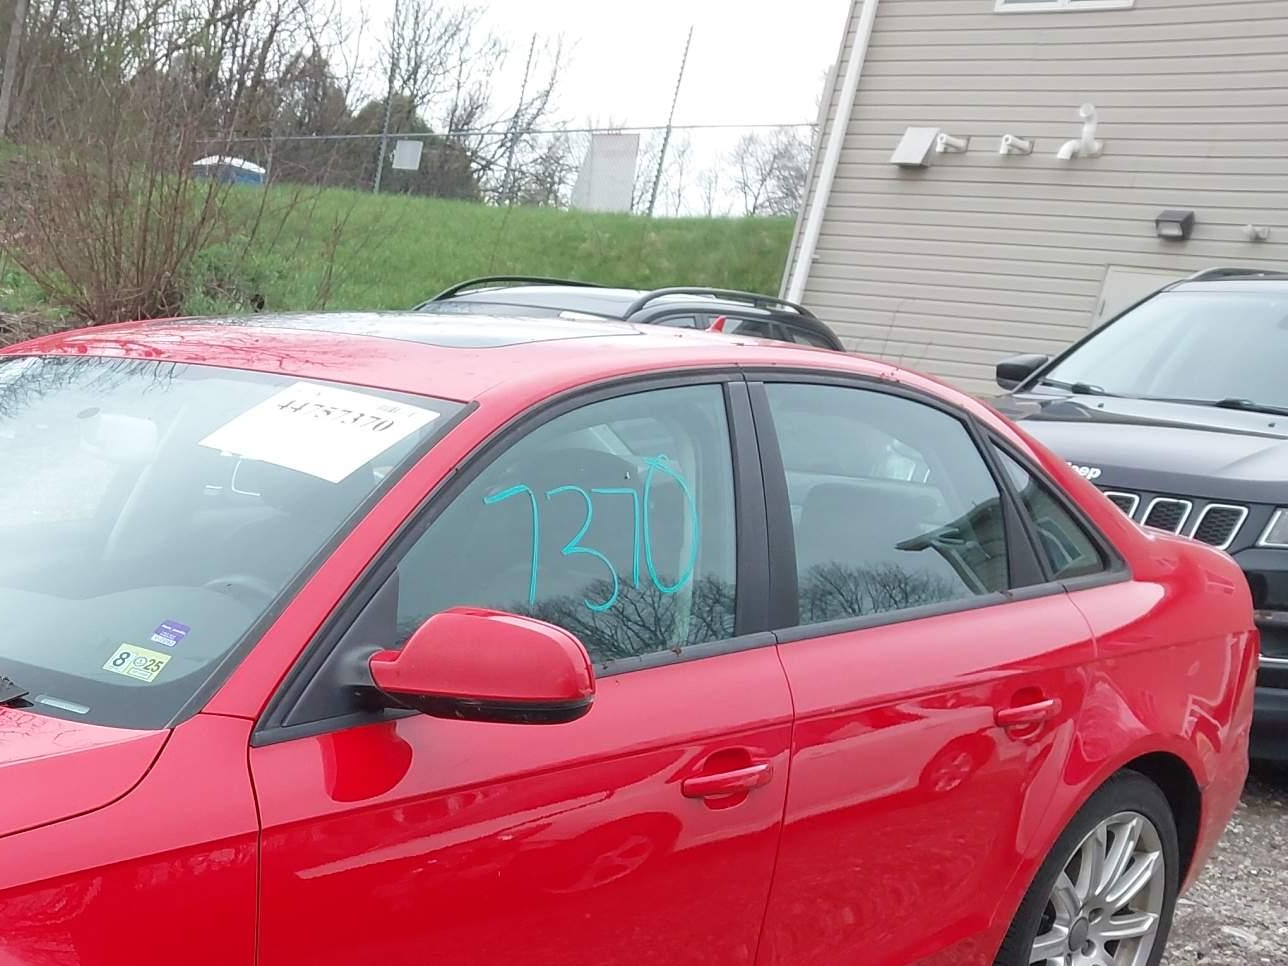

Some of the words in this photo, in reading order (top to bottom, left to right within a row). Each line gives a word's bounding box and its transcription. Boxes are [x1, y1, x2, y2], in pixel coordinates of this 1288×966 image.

[276, 399, 396, 432] 44757370
[482, 453, 699, 612] 7370
[112, 651, 131, 667] 8
[144, 658, 164, 673] 25
